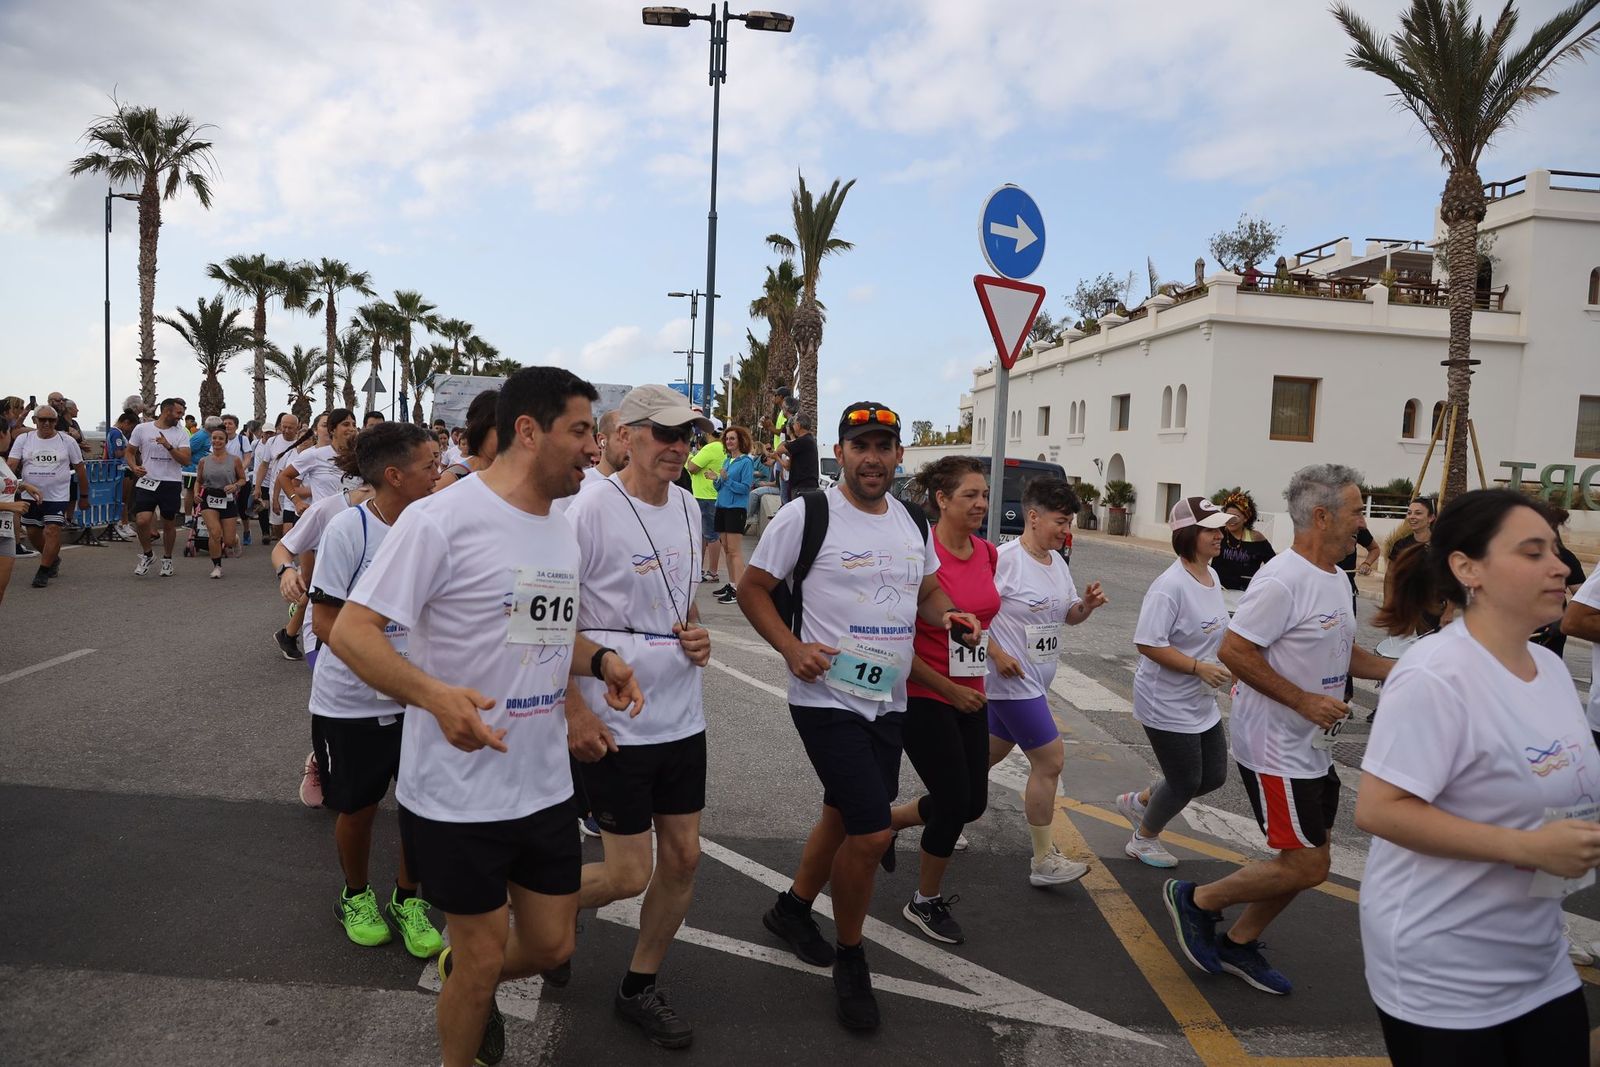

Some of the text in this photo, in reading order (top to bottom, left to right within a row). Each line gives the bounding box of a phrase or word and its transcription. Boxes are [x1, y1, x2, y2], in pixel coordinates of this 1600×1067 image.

[141, 478, 155, 487] 273
[530, 595, 574, 622] 616
[849, 625, 879, 635] DONACIÓN
[1036, 636, 1058, 651] 410
[955, 646, 985, 662] 116
[855, 662, 882, 684] 18
